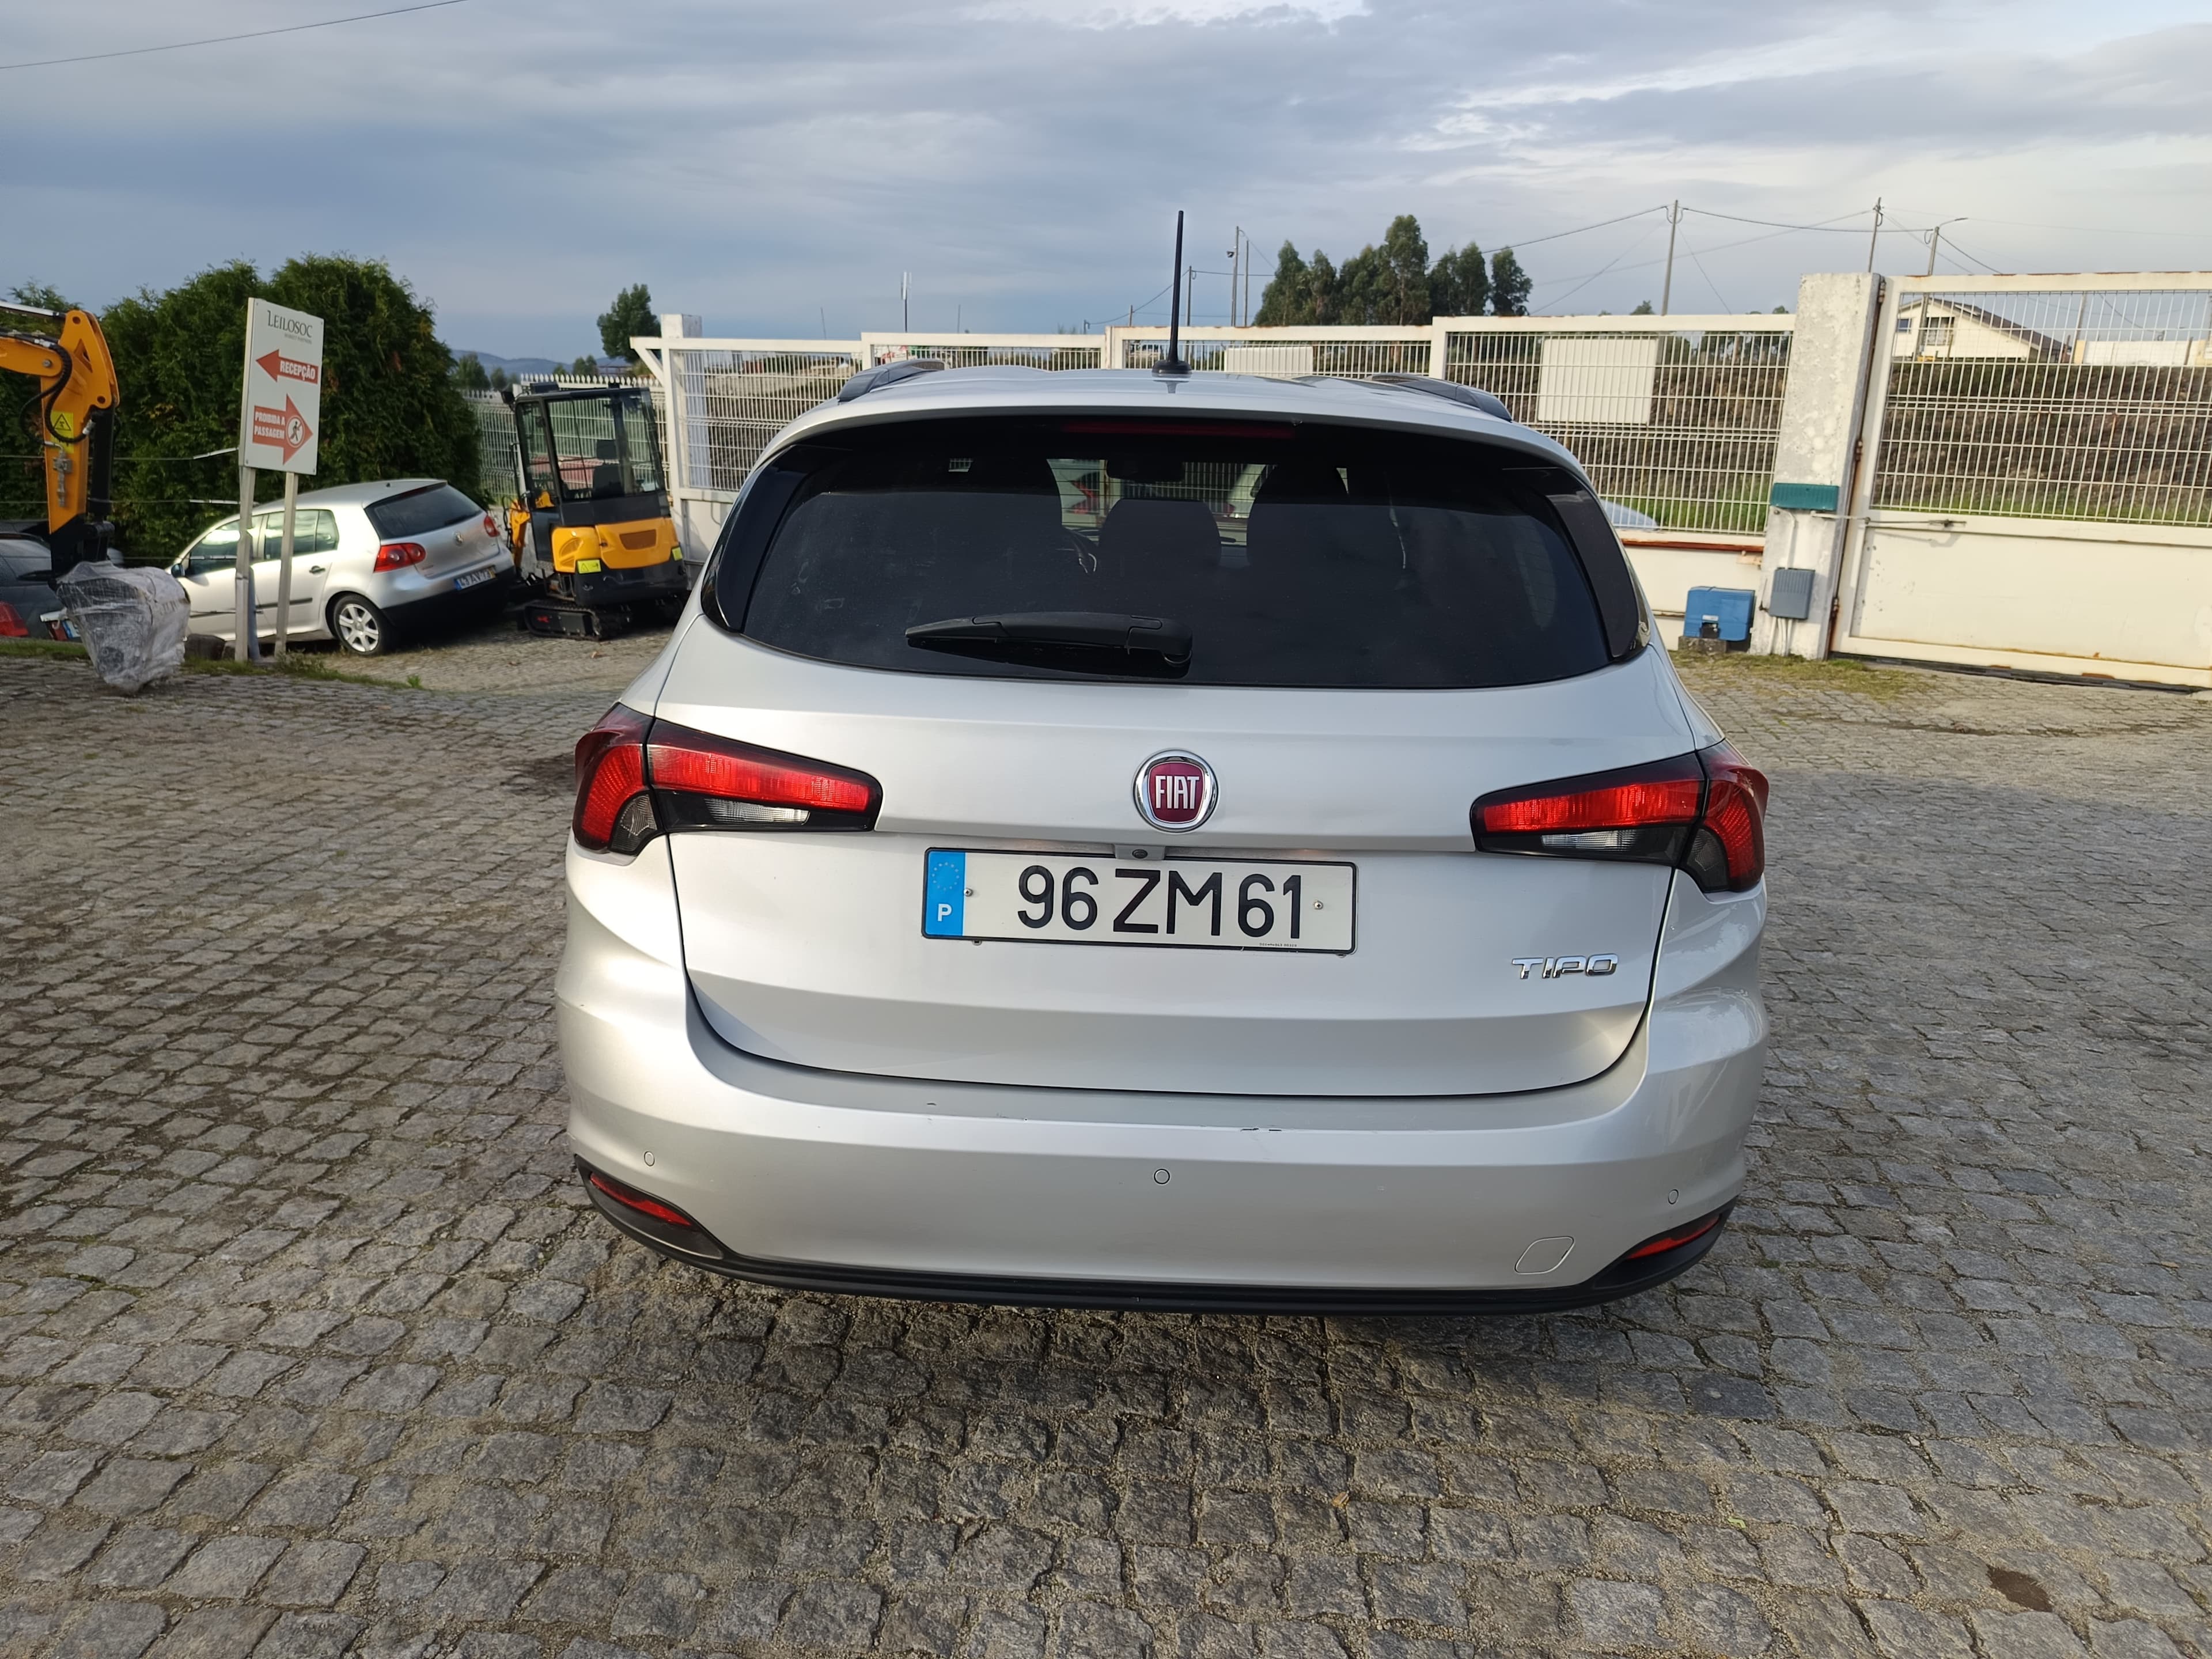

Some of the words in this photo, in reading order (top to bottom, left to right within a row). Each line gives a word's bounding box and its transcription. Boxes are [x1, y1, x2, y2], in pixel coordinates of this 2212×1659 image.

[267, 310, 313, 338] LEILOSOC
[280, 360, 316, 381] RECEPÇÃO
[255, 411, 281, 425] PROIBIDA
[281, 416, 286, 426] A
[254, 425, 285, 440] PASSAGEM
[1155, 775, 1200, 809] FIAT
[937, 903, 952, 922] P
[1512, 953, 1618, 979] TIPO
